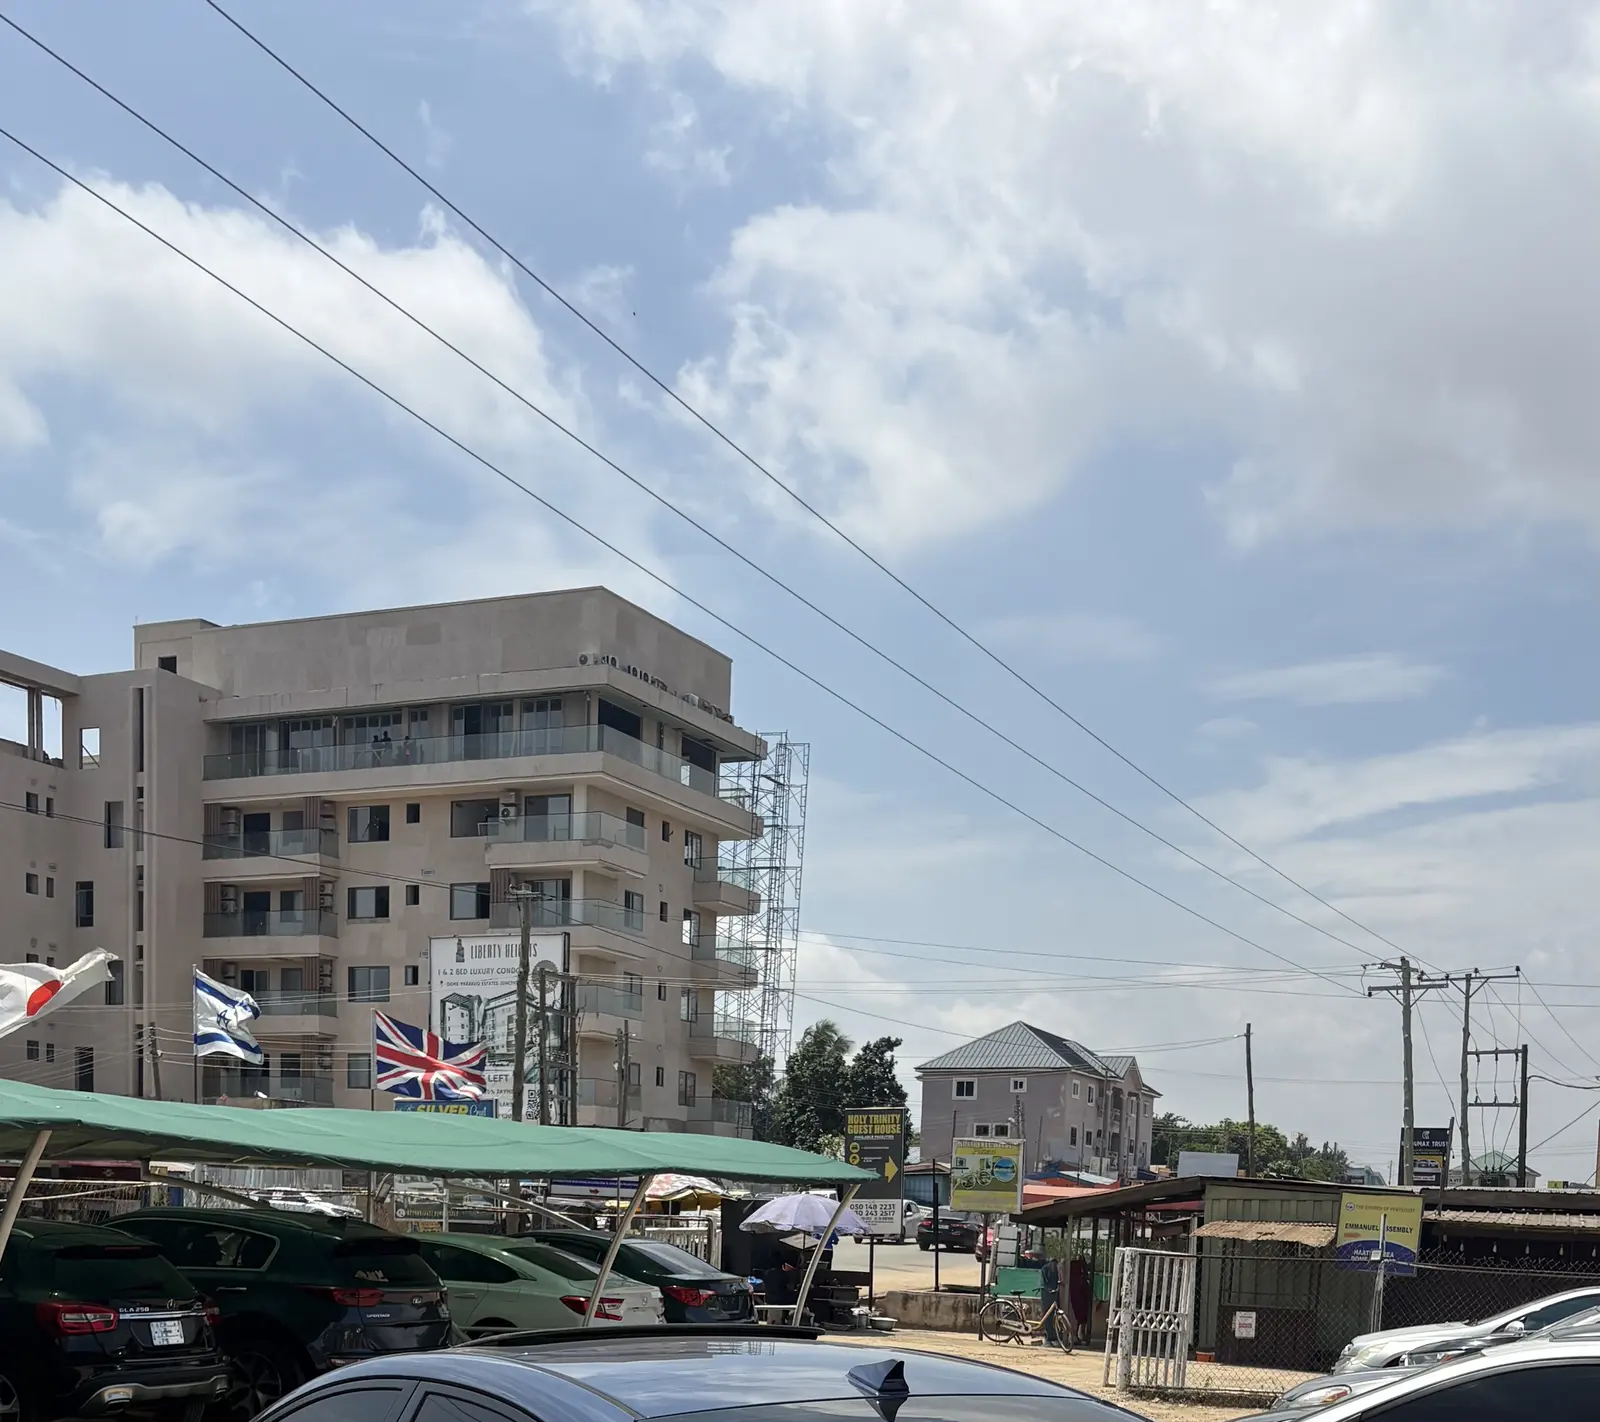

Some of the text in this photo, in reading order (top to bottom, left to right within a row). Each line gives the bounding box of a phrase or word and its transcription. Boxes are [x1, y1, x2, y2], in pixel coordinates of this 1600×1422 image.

[470, 943, 538, 959] LIBERTY HEITS
[442, 968, 448, 976] &
[449, 968, 454, 976] 2
[456, 968, 468, 976] BED
[470, 967, 495, 975] LUXURY
[488, 1074, 510, 1083] LEFT
[848, 1113, 901, 1124] HOLY TRINITY
[848, 1124, 901, 1134] GUEST HOUSE
[1344, 1222, 1414, 1234] EMMANUEL SSEMBLY
